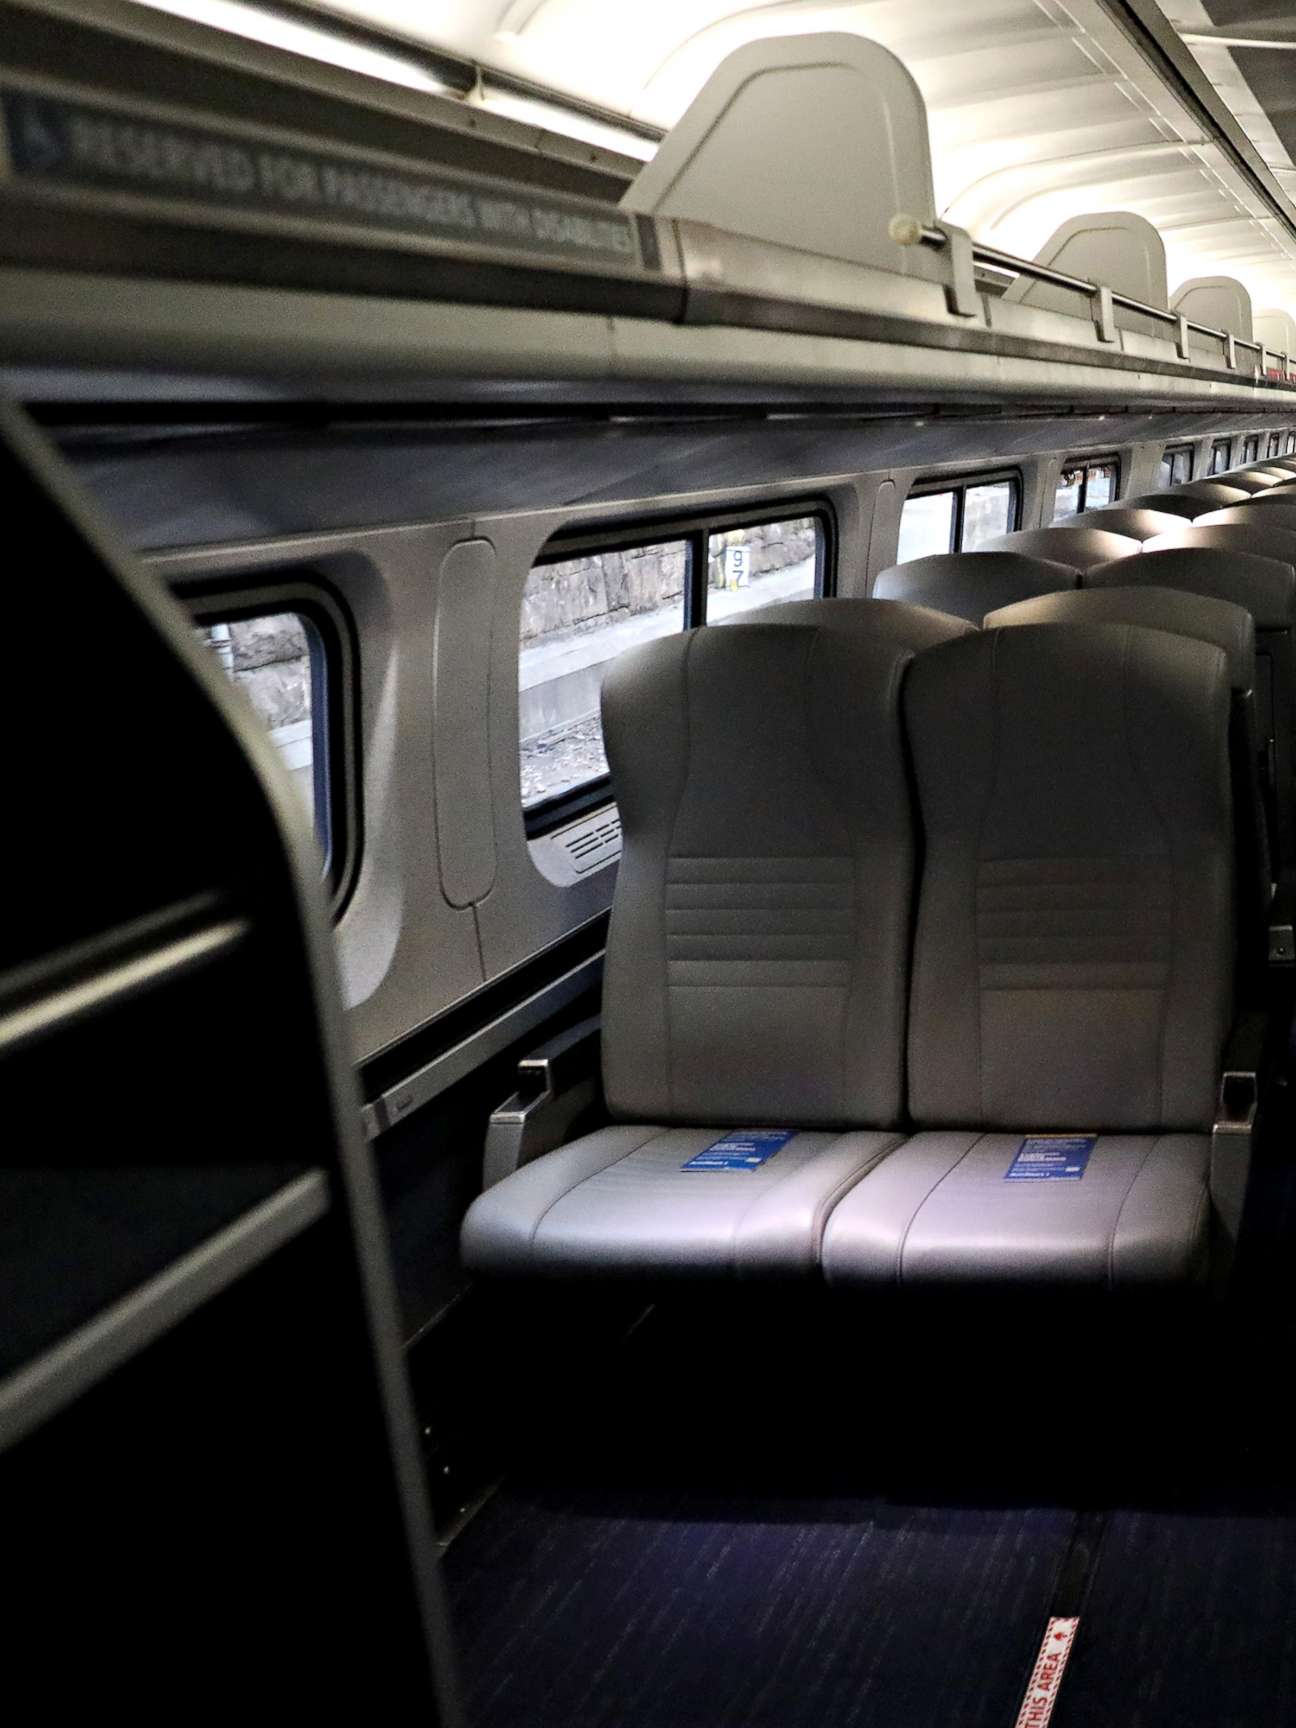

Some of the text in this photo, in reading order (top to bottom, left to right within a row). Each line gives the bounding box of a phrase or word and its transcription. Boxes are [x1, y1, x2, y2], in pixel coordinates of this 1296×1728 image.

[70, 116, 252, 192] RESERVED
[257, 152, 320, 201] FOR
[323, 163, 477, 229] PASSENGERS
[479, 200, 531, 233] WITH
[1024, 1652, 1061, 1728] THIS AREA
